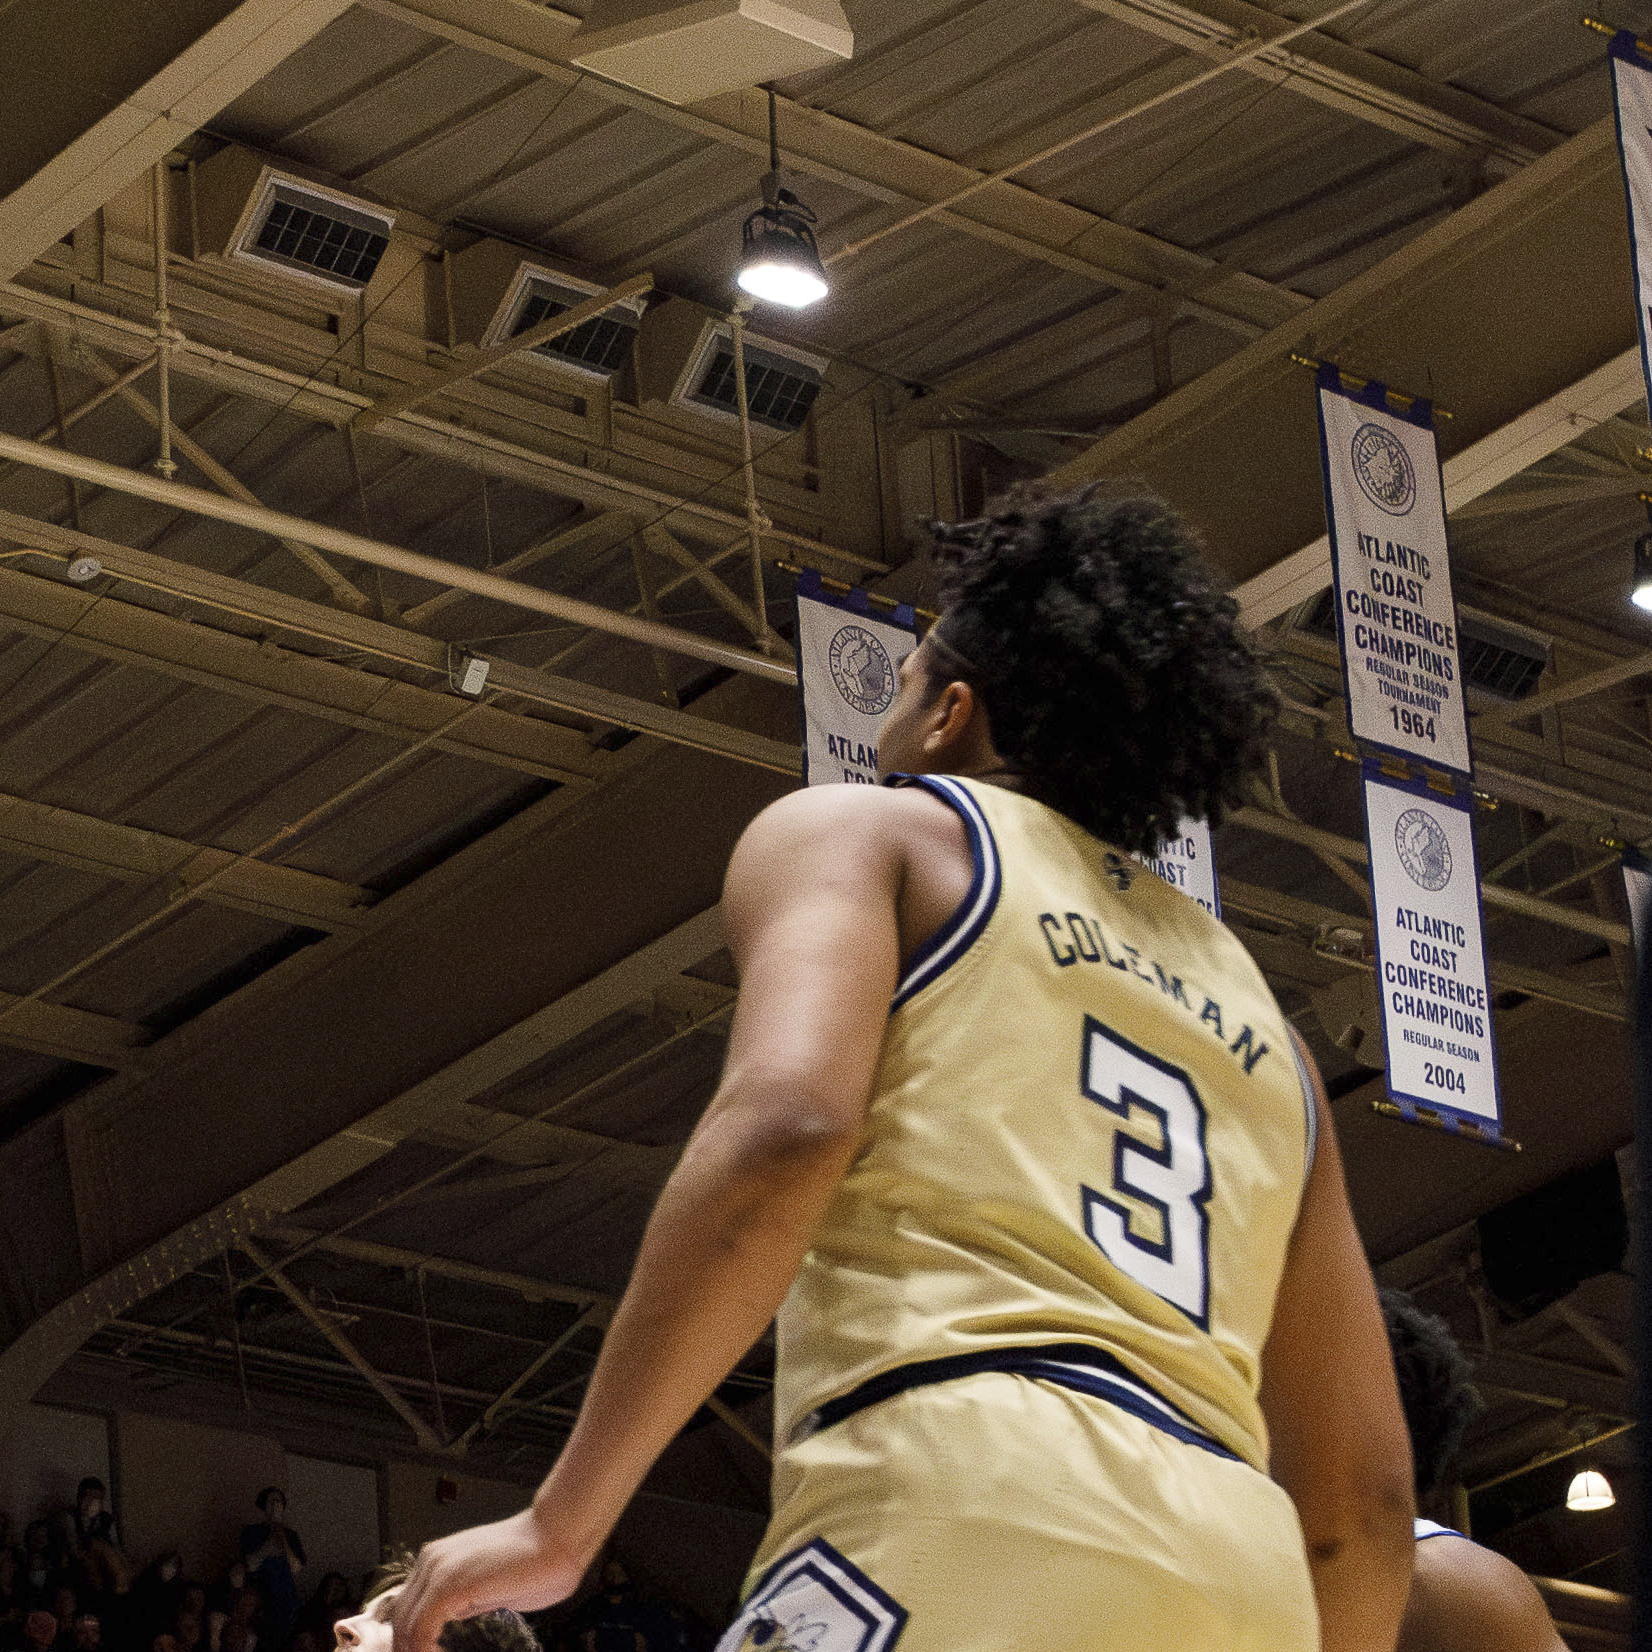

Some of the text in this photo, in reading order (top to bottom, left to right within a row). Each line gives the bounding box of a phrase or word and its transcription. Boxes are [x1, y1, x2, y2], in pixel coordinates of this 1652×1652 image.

[1358, 531, 1431, 580] ATLANTIC
[1370, 568, 1425, 608] COAST
[1346, 590, 1455, 650] CONFERENCE
[1355, 624, 1454, 682] CHAMPIONS
[1366, 656, 1450, 700] REGULAR SEASON
[1377, 678, 1442, 715] TOURNAMENT
[1389, 705, 1437, 743] 1964
[1396, 907, 1466, 948] ATLANTIC
[1410, 939, 1458, 974] COAST
[1038, 911, 1270, 1076] COLEMAN
[1385, 961, 1486, 1011] CONFERENCE
[1392, 992, 1484, 1038] CHAMPIONS
[1403, 1029, 1480, 1063] REGULAR SEASON
[1424, 1061, 1466, 1094] 2004
[1081, 1014, 1213, 1334] 3
